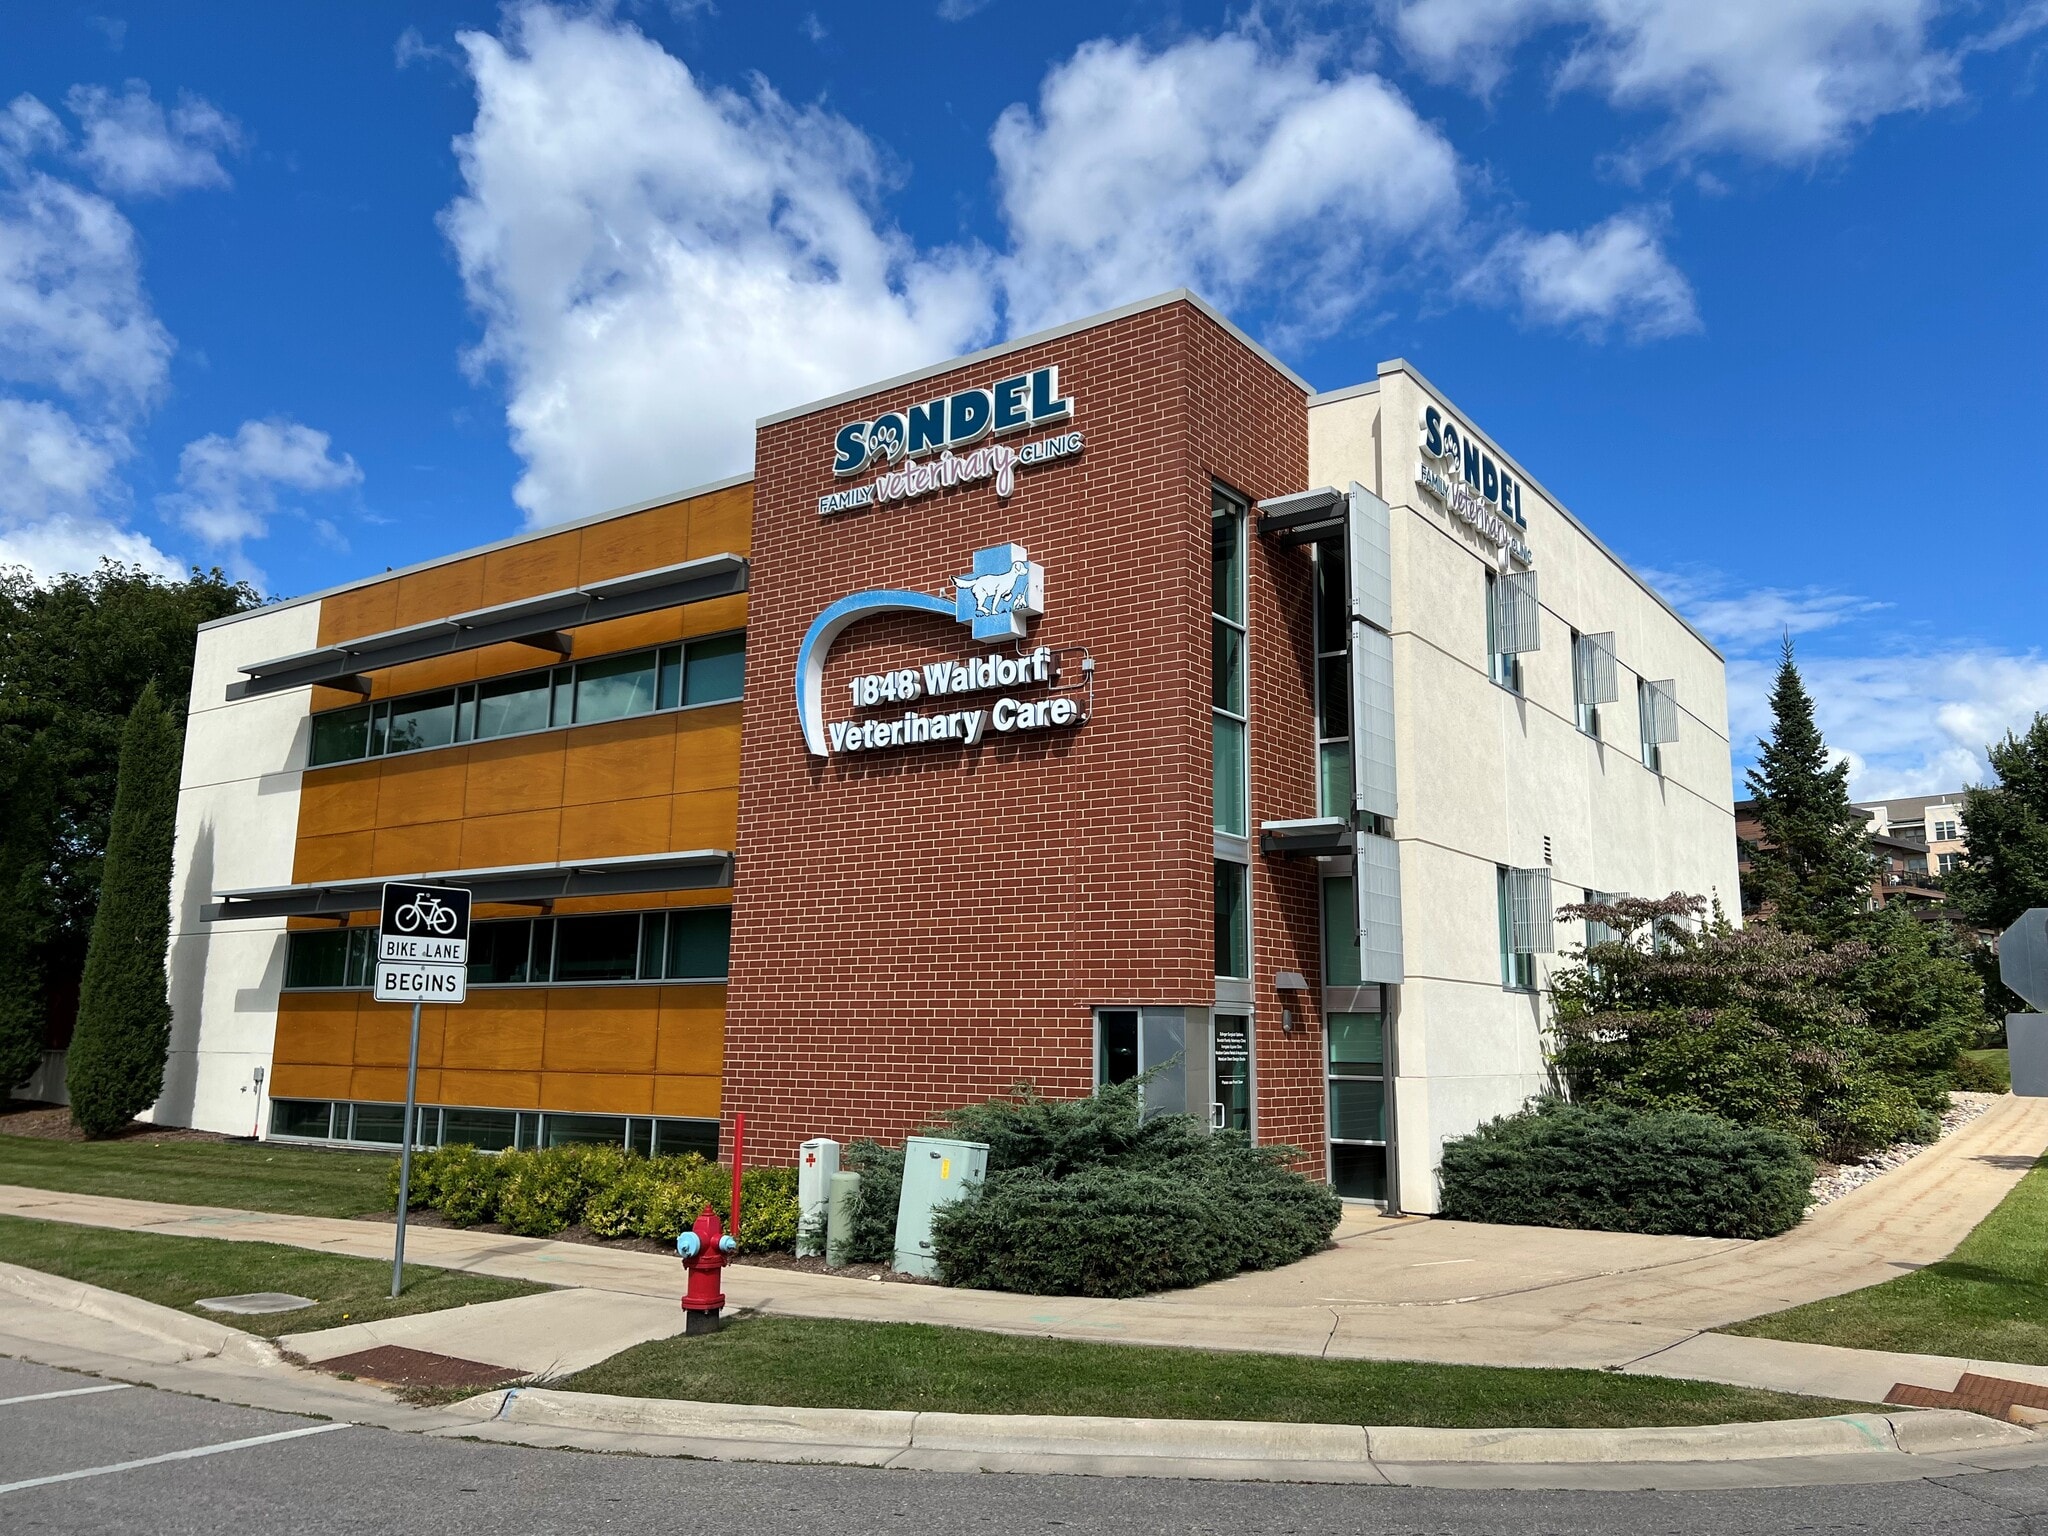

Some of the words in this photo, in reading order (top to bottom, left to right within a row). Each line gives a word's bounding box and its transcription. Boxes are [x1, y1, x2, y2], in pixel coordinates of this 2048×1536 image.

[832, 366, 1072, 475] SONDEL
[818, 484, 876, 515] FAMILY
[1019, 431, 1084, 465] CLINIC
[1424, 405, 1527, 531] SONDEL
[848, 667, 920, 706] 1848
[922, 647, 1050, 696] Waldorf
[828, 709, 986, 753] Veterinary
[992, 697, 1078, 733] Care
[387, 941, 417, 956] BIKE
[425, 943, 460, 959] LANE
[385, 972, 456, 992] BEGINS
